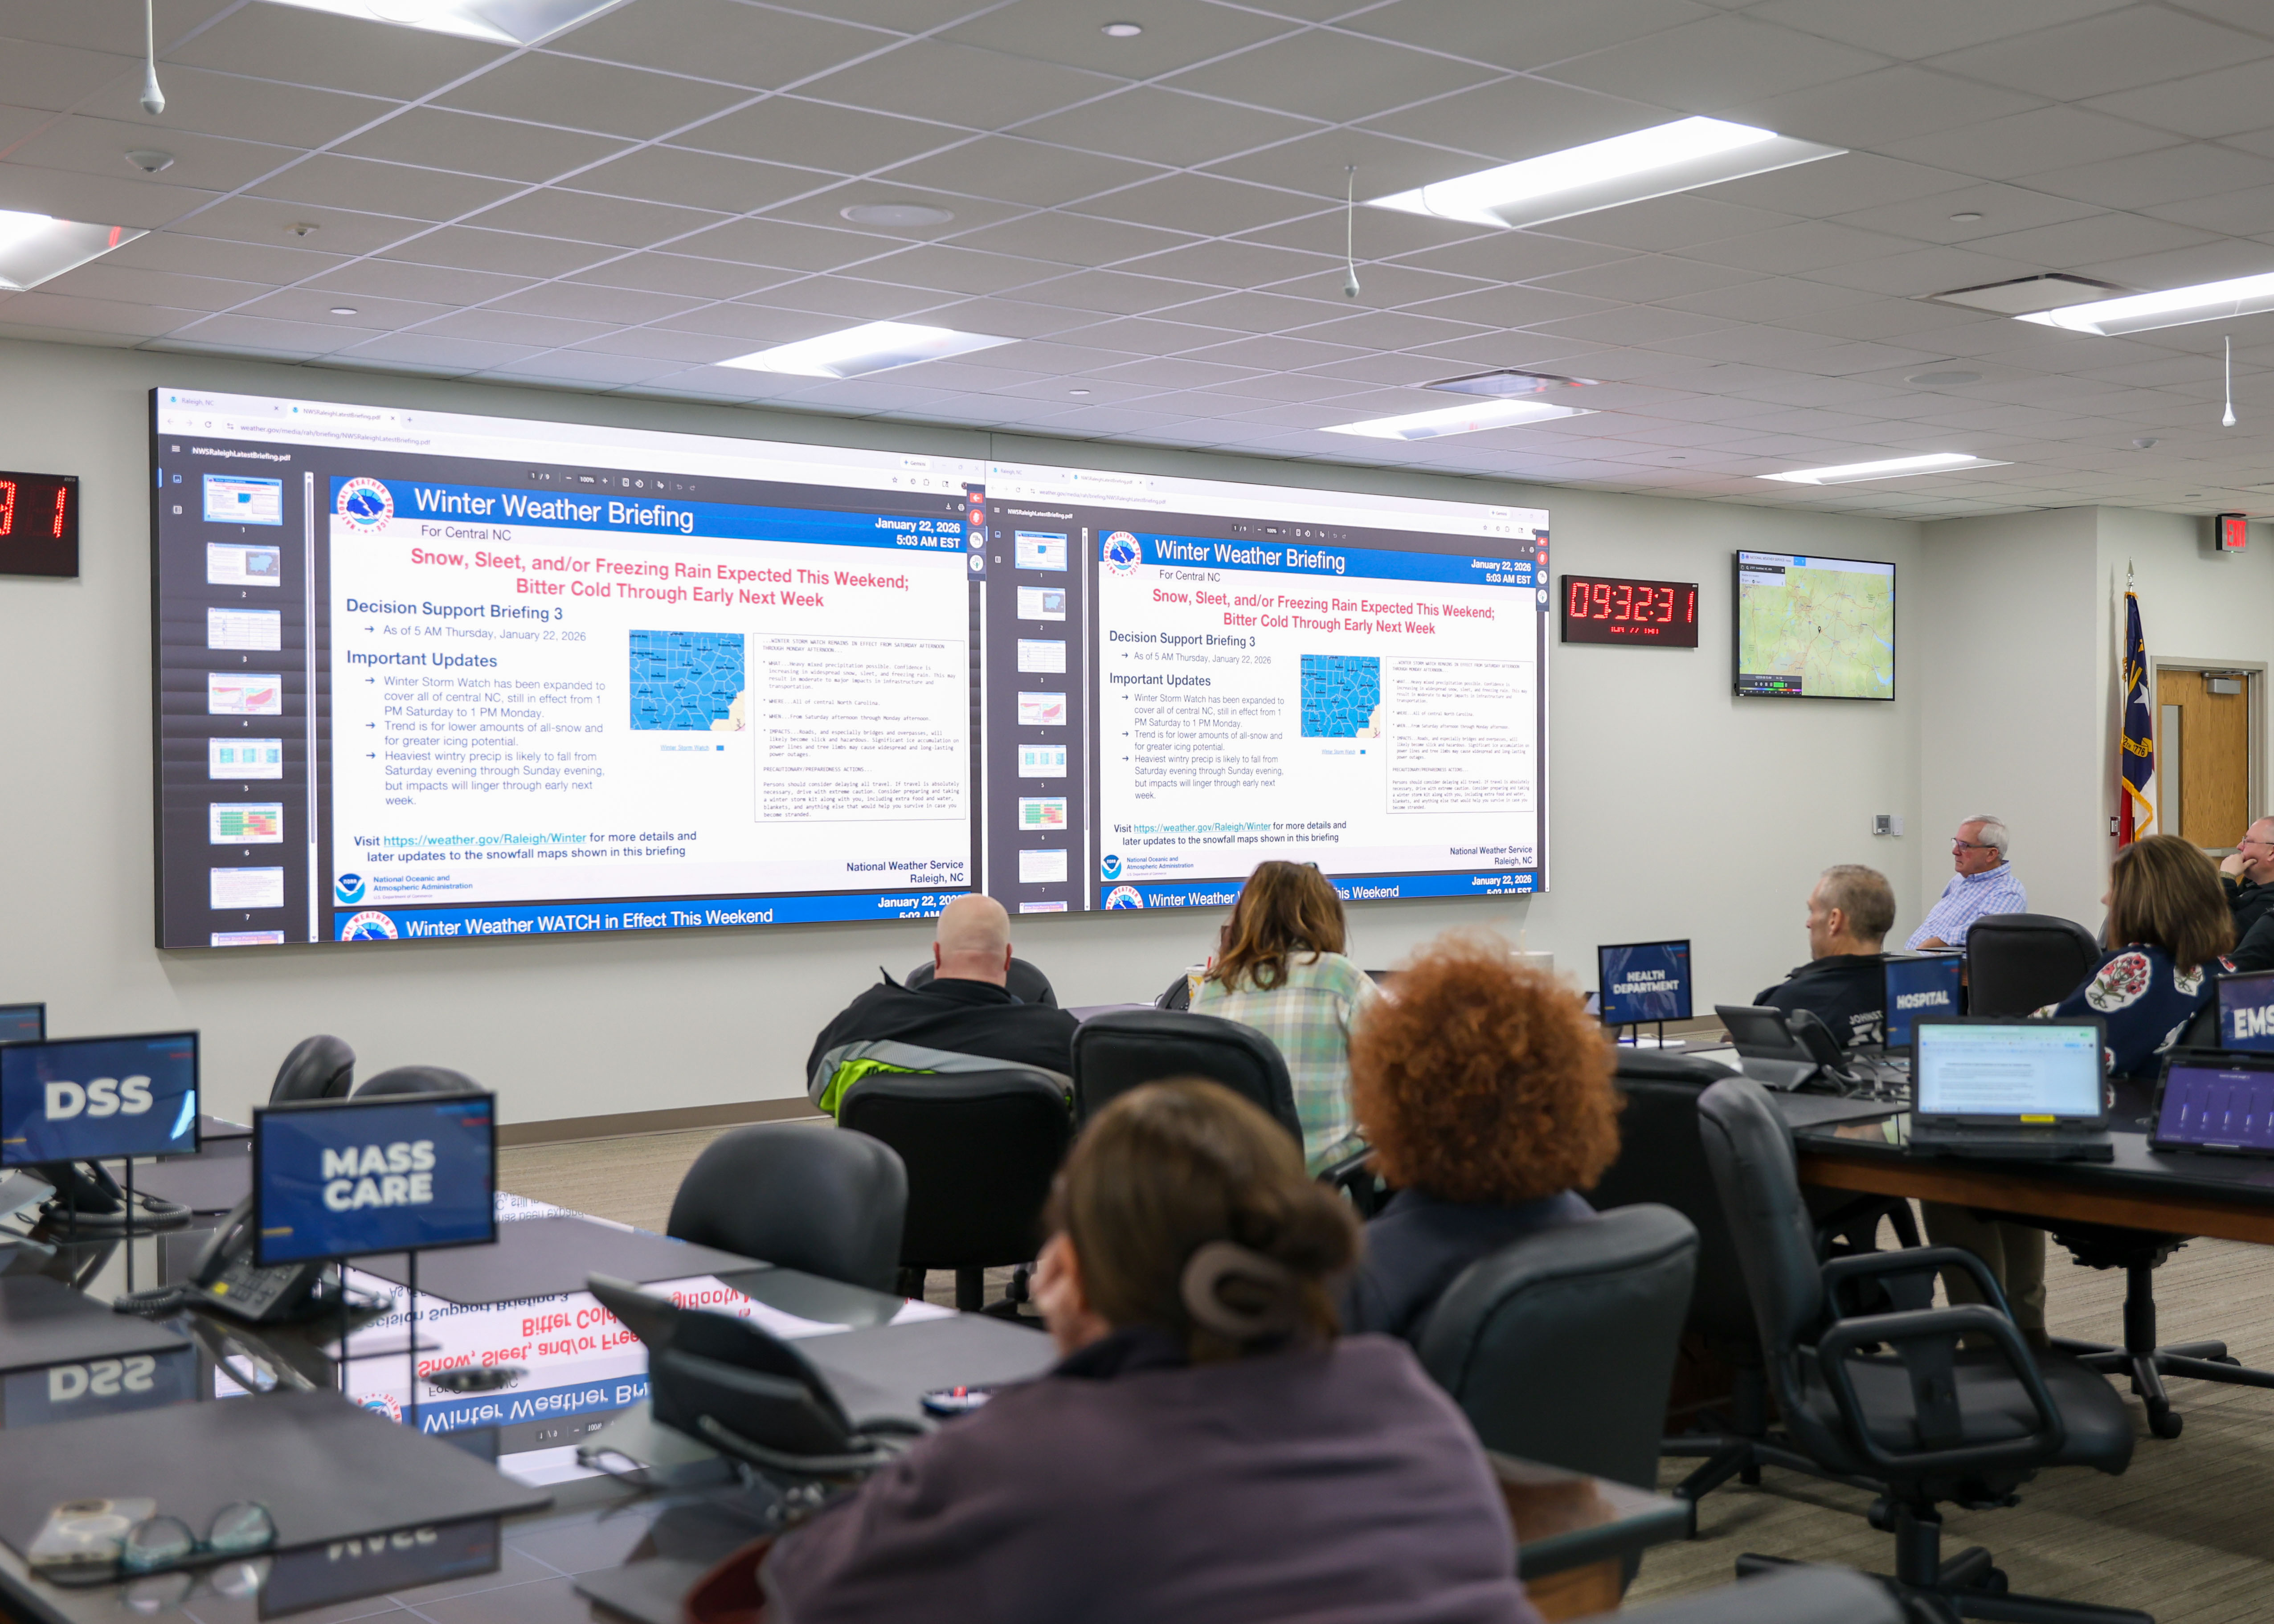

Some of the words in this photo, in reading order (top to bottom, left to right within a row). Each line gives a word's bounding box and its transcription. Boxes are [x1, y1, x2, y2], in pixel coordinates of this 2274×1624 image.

[181, 398, 204, 406] Raleigh,
[303, 408, 381, 421] NWSRaleighLatestBriefing.pdf
[192, 447, 291, 462] NWSRaleighLatestBriefing.pdf
[338, 490, 356, 530] NATIONAL
[348, 479, 386, 495] WEATHER
[376, 498, 393, 531] SERVICE
[415, 488, 496, 515] Winter
[502, 494, 601, 522] Weather
[609, 500, 695, 533] Briefing
[421, 525, 442, 537] For
[445, 526, 488, 539] Central
[493, 529, 511, 541] NC
[875, 518, 917, 533] January
[919, 520, 934, 533] 22,
[936, 522, 961, 534] 2026
[2226, 519, 2246, 547] EXIT
[896, 535, 918, 546] 5:03
[920, 536, 937, 547] AM
[940, 537, 961, 548] EST
[1155, 539, 1211, 561] Winter
[1214, 543, 1282, 565] Weather
[1287, 546, 1345, 574] Briefing
[1471, 559, 1501, 571] January
[1501, 561, 1513, 572] 22,
[1514, 562, 1531, 572] 2026
[411, 547, 469, 570] Snow,
[475, 551, 526, 572] Sleet,
[532, 556, 591, 572] and/or
[596, 558, 669, 580] Freezing
[675, 562, 711, 579] Rain
[717, 564, 792, 584] Expected
[797, 569, 830, 585] This
[834, 571, 908, 592] Weekend;
[1486, 573, 1501, 583] 5:03
[1502, 574, 1515, 583] AM
[1517, 575, 1531, 584] EST
[517, 578, 566, 595] Bitter
[571, 580, 611, 597] Cold
[616, 583, 687, 604] Through
[693, 586, 734, 607] Early
[738, 587, 776, 605] Next
[780, 591, 824, 607] Week
[347, 598, 417, 614] Decision
[422, 601, 485, 619] Support
[491, 604, 549, 623] Briefing
[554, 607, 563, 620] 3
[1153, 588, 1192, 606] Snow,
[1195, 591, 1230, 608] Sleet,
[1234, 594, 1274, 608] and/or
[1278, 595, 1328, 613] Freezing
[1332, 598, 1357, 612] Rain
[1361, 600, 1413, 616] Expected
[1416, 603, 1440, 616] This
[1442, 604, 1494, 621] Weekend;
[1224, 612, 1257, 626] Bitter
[1261, 614, 1288, 628] Cold
[1292, 615, 1341, 633] Through
[1345, 618, 1373, 635] Early
[1375, 618, 1402, 633] Next
[1405, 621, 1436, 634] Week
[383, 624, 398, 635] As
[400, 625, 412, 636] of
[414, 626, 421, 636] 5
[424, 626, 442, 636] AM
[445, 627, 496, 641] Thursday,
[499, 629, 540, 642] January
[543, 630, 558, 641] 22,
[561, 631, 586, 641] 2026
[1110, 630, 1157, 643] Decision
[1160, 632, 1203, 647] Support
[1206, 634, 1246, 649] Briefing
[1249, 636, 1256, 647] 3
[347, 650, 427, 668] Important
[432, 653, 497, 669] Updates
[384, 676, 419, 686] Winter
[422, 677, 454, 687] Storm
[457, 677, 491, 688] Watch
[494, 678, 512, 689] has
[515, 679, 540, 689] been
[543, 681, 593, 692] expanded
[595, 682, 605, 690] to
[384, 693, 414, 701] cover
[417, 691, 429, 701] all
[432, 691, 443, 702] of
[446, 693, 481, 702] central
[485, 692, 504, 703] NC,
[507, 694, 524, 703] still
[539, 694, 567, 704] effect
[570, 694, 593, 704] from
[596, 695, 600, 704] 1
[384, 706, 402, 716] PM
[406, 706, 454, 719] Saturday
[456, 708, 467, 717] to
[471, 708, 475, 717] 1
[480, 707, 497, 717] PM
[501, 708, 544, 720] Monday.
[2133, 744, 2146, 756] 1776
[353, 836, 380, 846] Visit
[384, 833, 587, 848] https://weather.gov/Raleigh/Winter
[589, 832, 605, 842] for
[608, 834, 636, 842] more
[639, 831, 674, 841] details
[677, 831, 696, 841] and
[847, 861, 886, 872] National
[888, 861, 928, 870] Weather
[930, 860, 964, 869] Service
[910, 873, 947, 885] Raleigh,
[950, 873, 964, 882] NC
[406, 921, 461, 936] Winter
[465, 918, 534, 934] Weather
[538, 914, 600, 931] WATCH
[605, 914, 618, 928] in
[623, 913, 667, 928] Effect
[671, 911, 702, 926] This
[706, 908, 773, 924] Weekend
[1627, 969, 1665, 983] HEALTH
[1612, 979, 1680, 995] DEPARTMENT
[1896, 989, 1951, 1010] HOSPITAL
[2233, 1004, 2274, 1040] EMS
[45, 1074, 153, 1121] DSS
[322, 1139, 436, 1180] MASS
[323, 1172, 434, 1213] CARE
